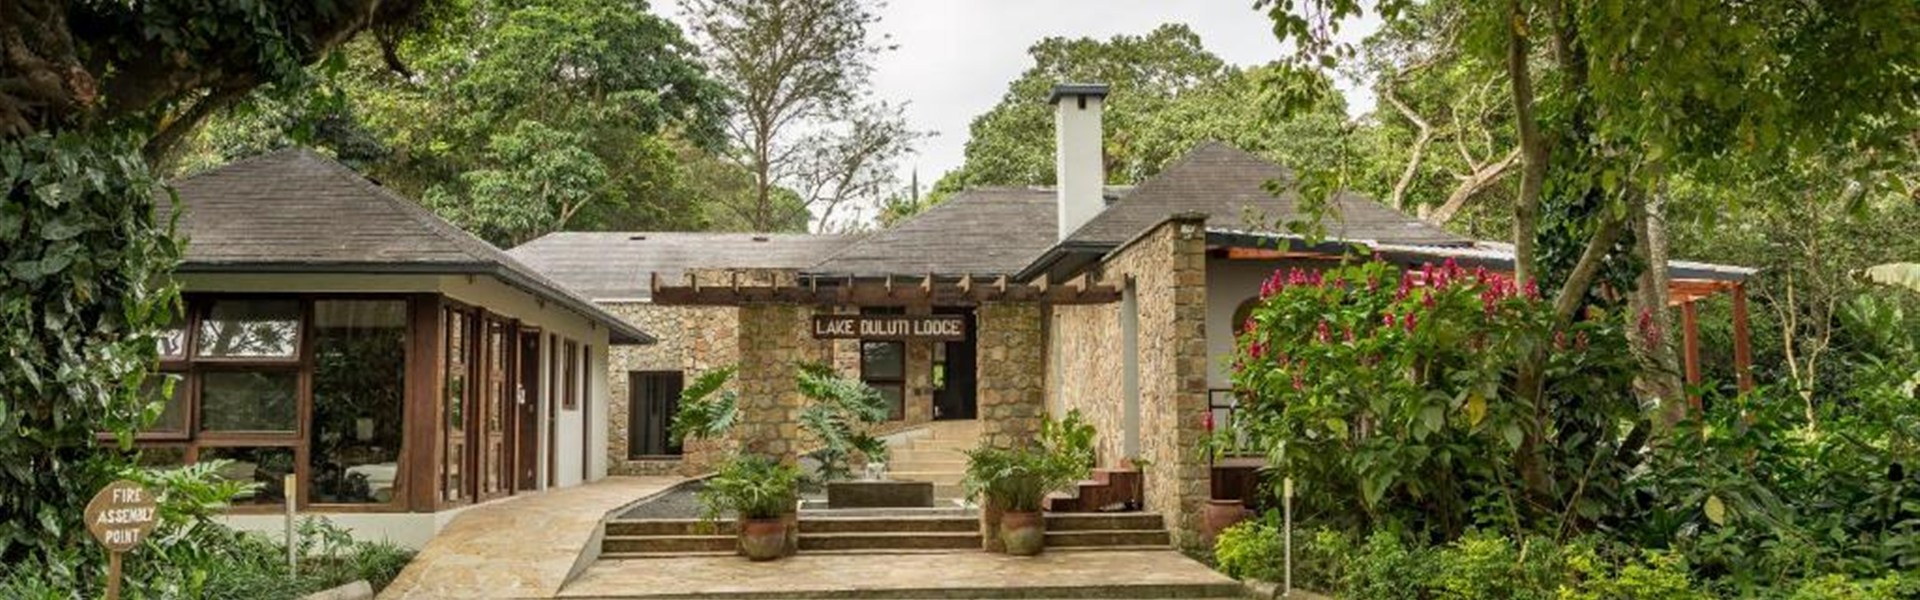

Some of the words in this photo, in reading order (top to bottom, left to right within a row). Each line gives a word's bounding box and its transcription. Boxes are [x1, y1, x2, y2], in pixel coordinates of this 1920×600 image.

[816, 319, 855, 335] LAKE
[860, 319, 910, 335] DULUTI
[914, 319, 961, 336] LODGE
[112, 487, 143, 504] FIRE
[95, 506, 156, 526] ASSEMBLY
[105, 528, 140, 544] POINT
